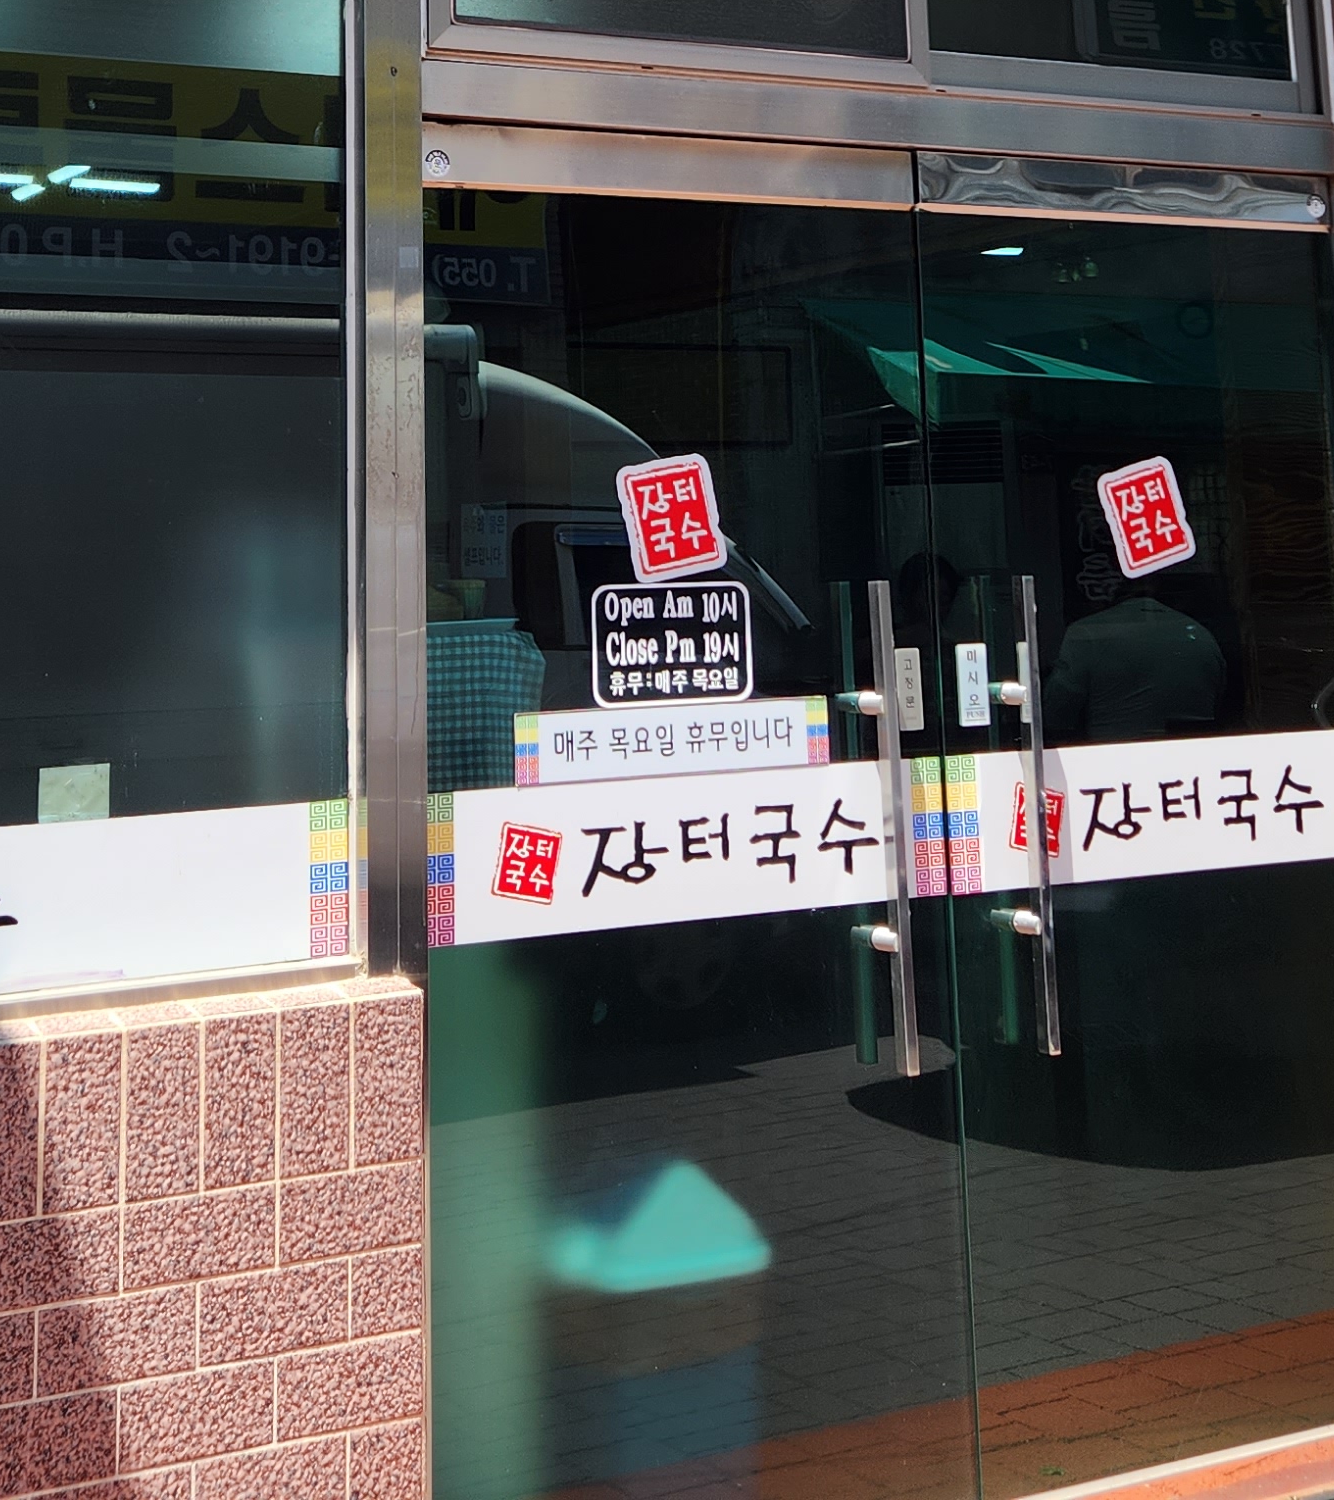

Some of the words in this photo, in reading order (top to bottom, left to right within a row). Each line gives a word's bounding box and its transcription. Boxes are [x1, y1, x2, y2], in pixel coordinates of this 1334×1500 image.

[636, 476, 698, 521] 장터
[1114, 477, 1166, 522] 장터
[649, 510, 709, 559] 국수
[1129, 509, 1178, 553] 국수
[604, 591, 655, 626] Open
[662, 589, 694, 619] Am
[701, 590, 738, 623] 10시
[605, 630, 659, 667] Close
[664, 629, 697, 663] Pm
[702, 630, 740, 664] 19시
[692, 666, 739, 693] 목요일
[966, 649, 981, 706] 미시오
[553, 729, 599, 763] 매주
[608, 723, 677, 760] 목요일
[685, 716, 794, 753] 휴무입니다
[1078, 764, 1325, 852] 장터국수
[505, 831, 554, 860] 장터
[580, 797, 881, 898] 장터국수
[505, 860, 550, 893] 국수
